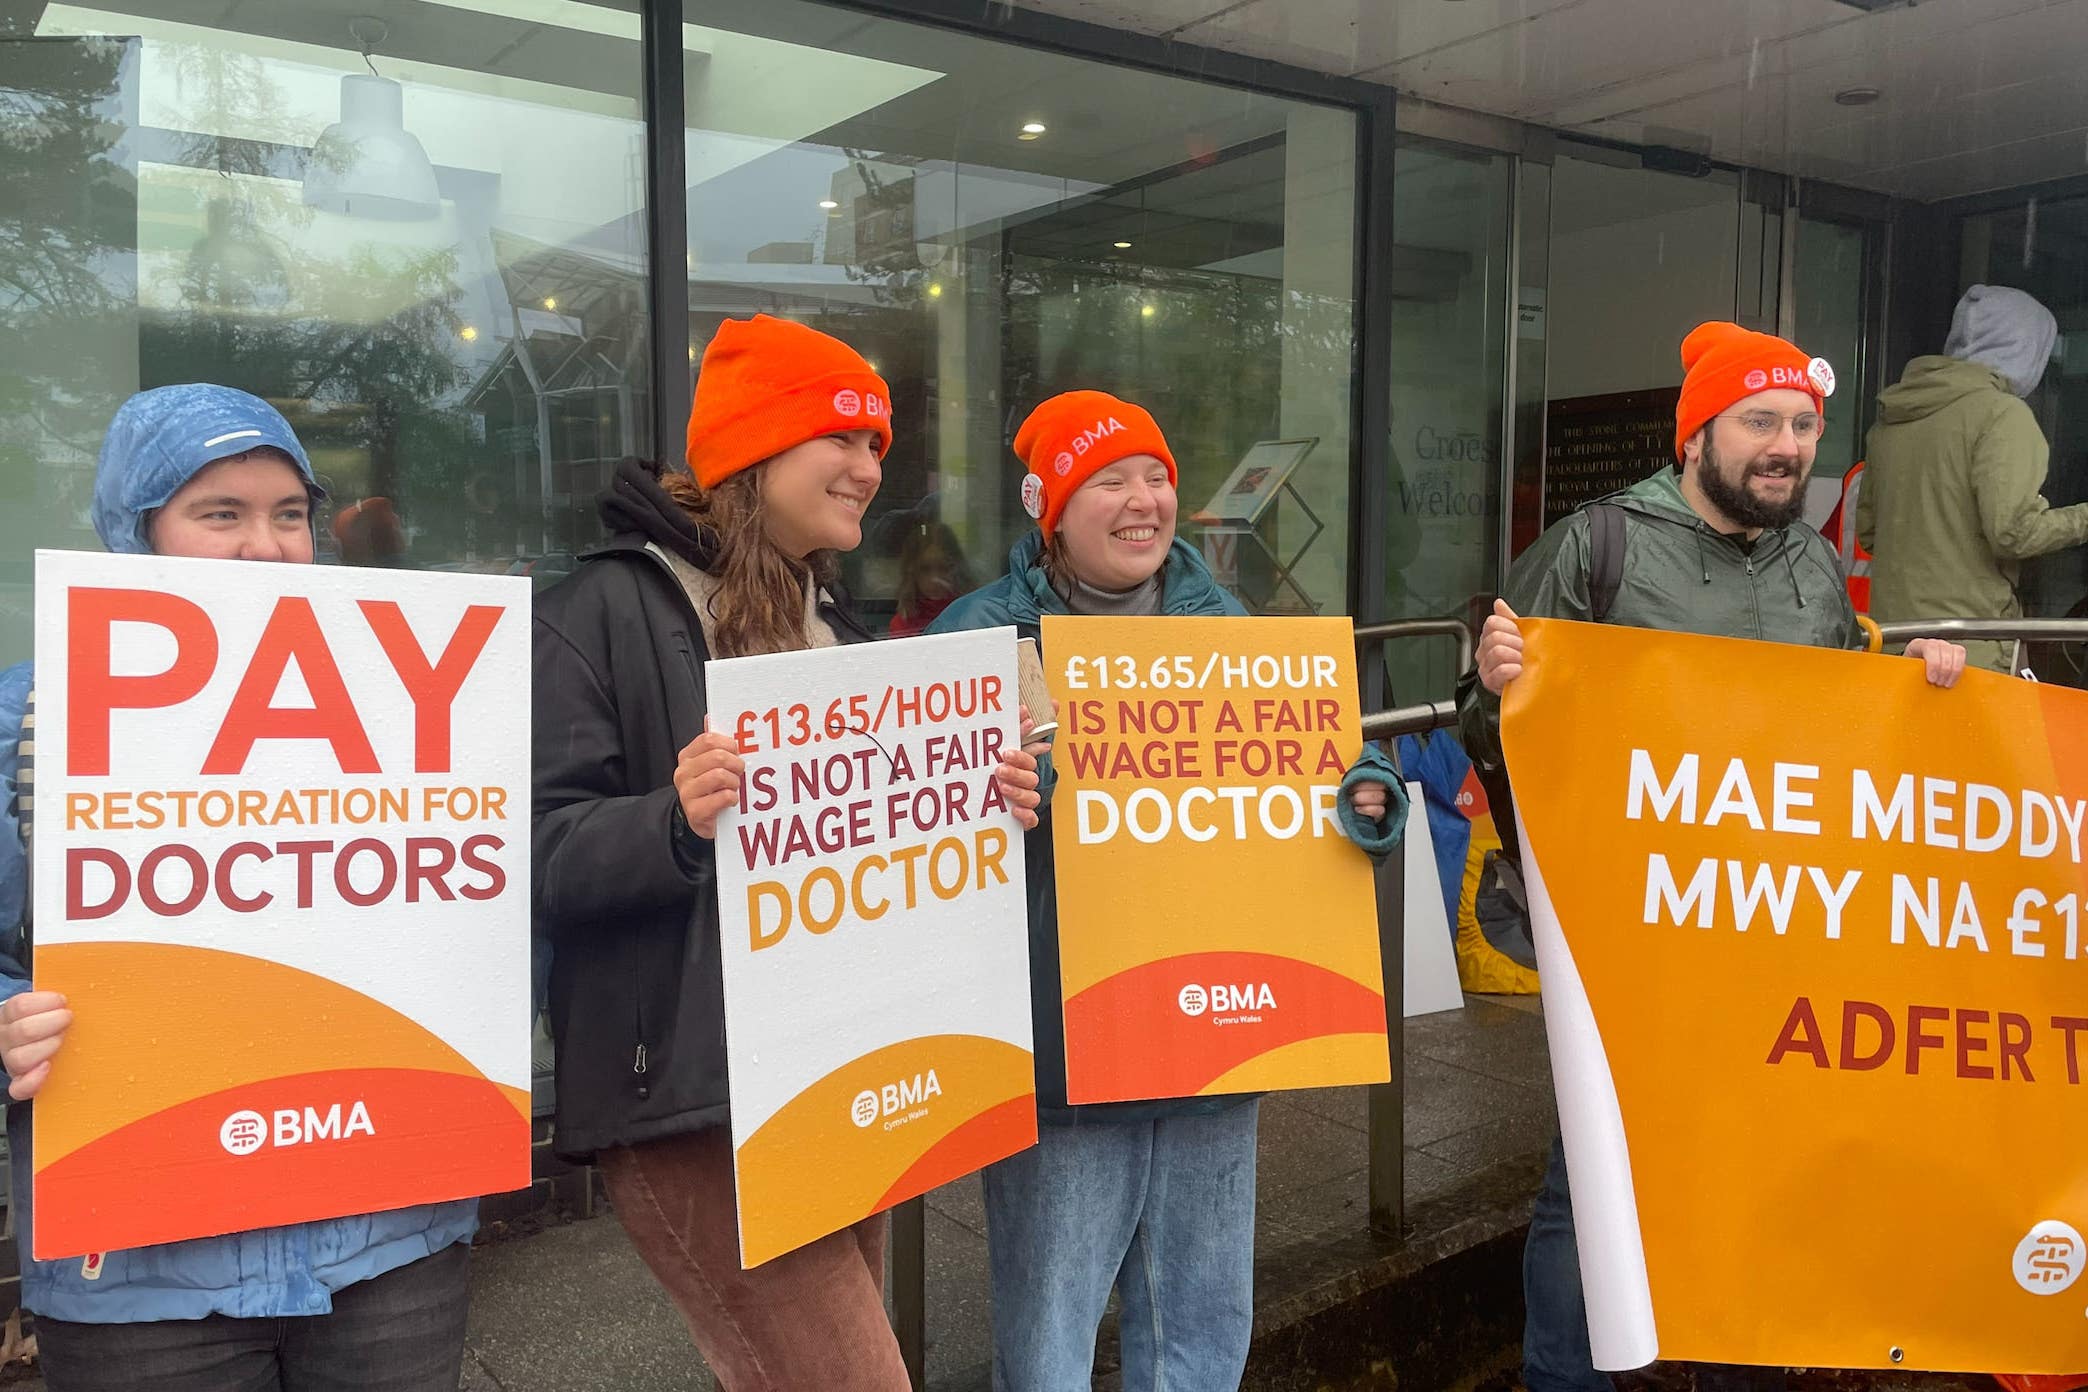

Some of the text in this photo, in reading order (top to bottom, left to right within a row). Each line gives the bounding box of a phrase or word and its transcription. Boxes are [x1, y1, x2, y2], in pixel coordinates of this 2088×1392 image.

[1772, 367, 1808, 386] BM
[866, 393, 892, 419] BM
[1072, 416, 1128, 456] BMA
[67, 586, 506, 776] PAY
[1065, 652, 1338, 690] £13.65/HOUR
[734, 675, 1003, 755] £13.65/HOUR
[1069, 699, 1343, 735] IS NOT A FAIR
[738, 727, 1004, 815] IS NOT A FAIR
[1068, 739, 1346, 780] WAGE FOR A
[66, 786, 507, 831] RESTORATION FOR
[738, 774, 1008, 871] WAGE FOR A
[1626, 749, 2087, 863] MAE MEDDY
[66, 834, 507, 921] DOCTORS
[747, 827, 1009, 952] DOCTOR
[1643, 853, 2088, 960] MWY NA £1
[1210, 982, 1277, 1012] BMA
[1213, 1015, 1262, 1026] Cymru Wales
[1765, 996, 2036, 1082] ADFER
[881, 1068, 942, 1117] BMA
[273, 1100, 376, 1147] BMA
[883, 1115, 908, 1132] Cymru
